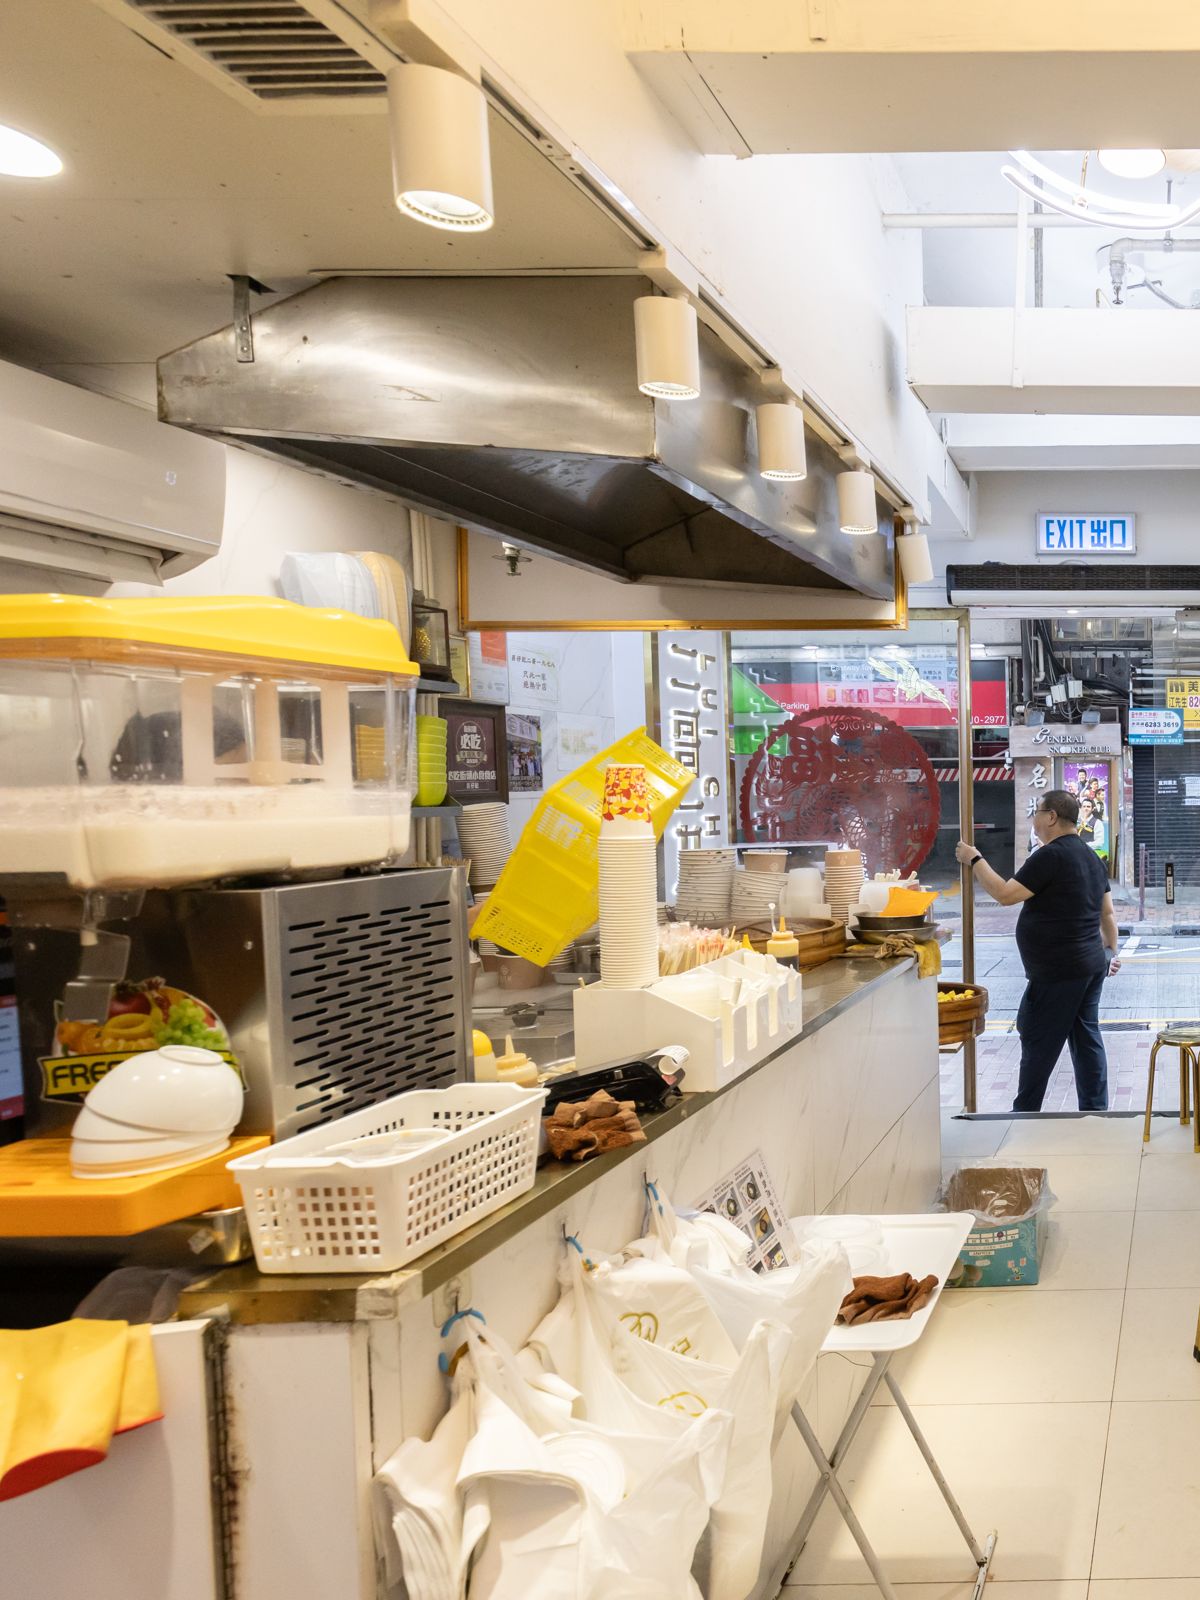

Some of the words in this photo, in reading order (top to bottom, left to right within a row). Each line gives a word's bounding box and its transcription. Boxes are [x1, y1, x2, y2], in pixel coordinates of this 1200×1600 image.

[1045, 519, 1086, 548] EXIT
[1090, 519, 1126, 548] 出口
[780, 702, 810, 713] Parking
[1032, 727, 1086, 744] GENERAL
[1048, 745, 1088, 754] SNOOKER
[1088, 745, 1111, 754] CLUB
[51, 1060, 127, 1089] FRE
